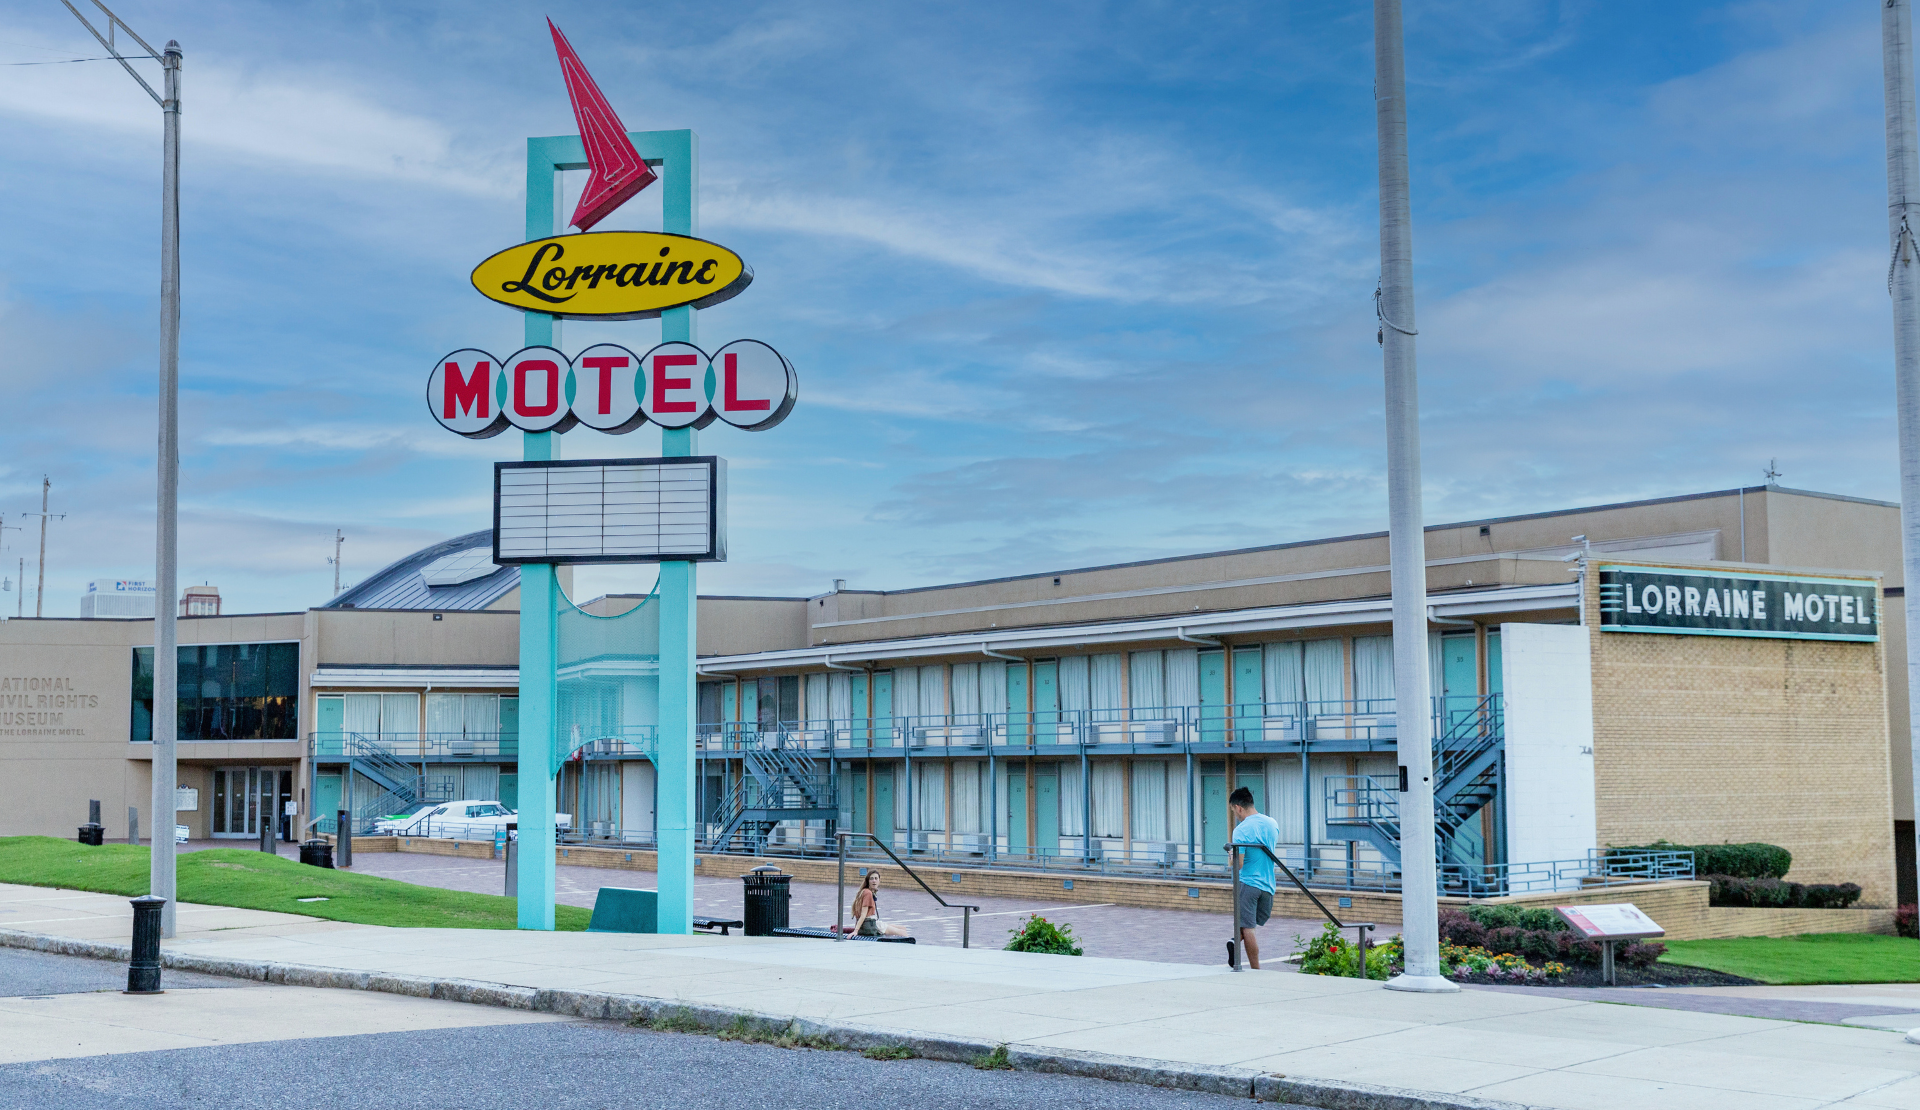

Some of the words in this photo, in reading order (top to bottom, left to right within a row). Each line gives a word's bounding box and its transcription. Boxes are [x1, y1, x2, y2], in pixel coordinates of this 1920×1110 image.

[501, 242, 719, 303] Lorraine
[443, 352, 771, 419] MOTEL
[1625, 583, 1767, 620] LORRAINE
[1784, 591, 1871, 625] MOTEL
[0, 677, 74, 692] ATIONAL
[0, 694, 33, 709] IVIL
[37, 694, 99, 709] RIGHTS
[0, 712, 64, 726] USEUM
[16, 728, 57, 736] LORRAINE
[59, 728, 86, 736] MOTEL
